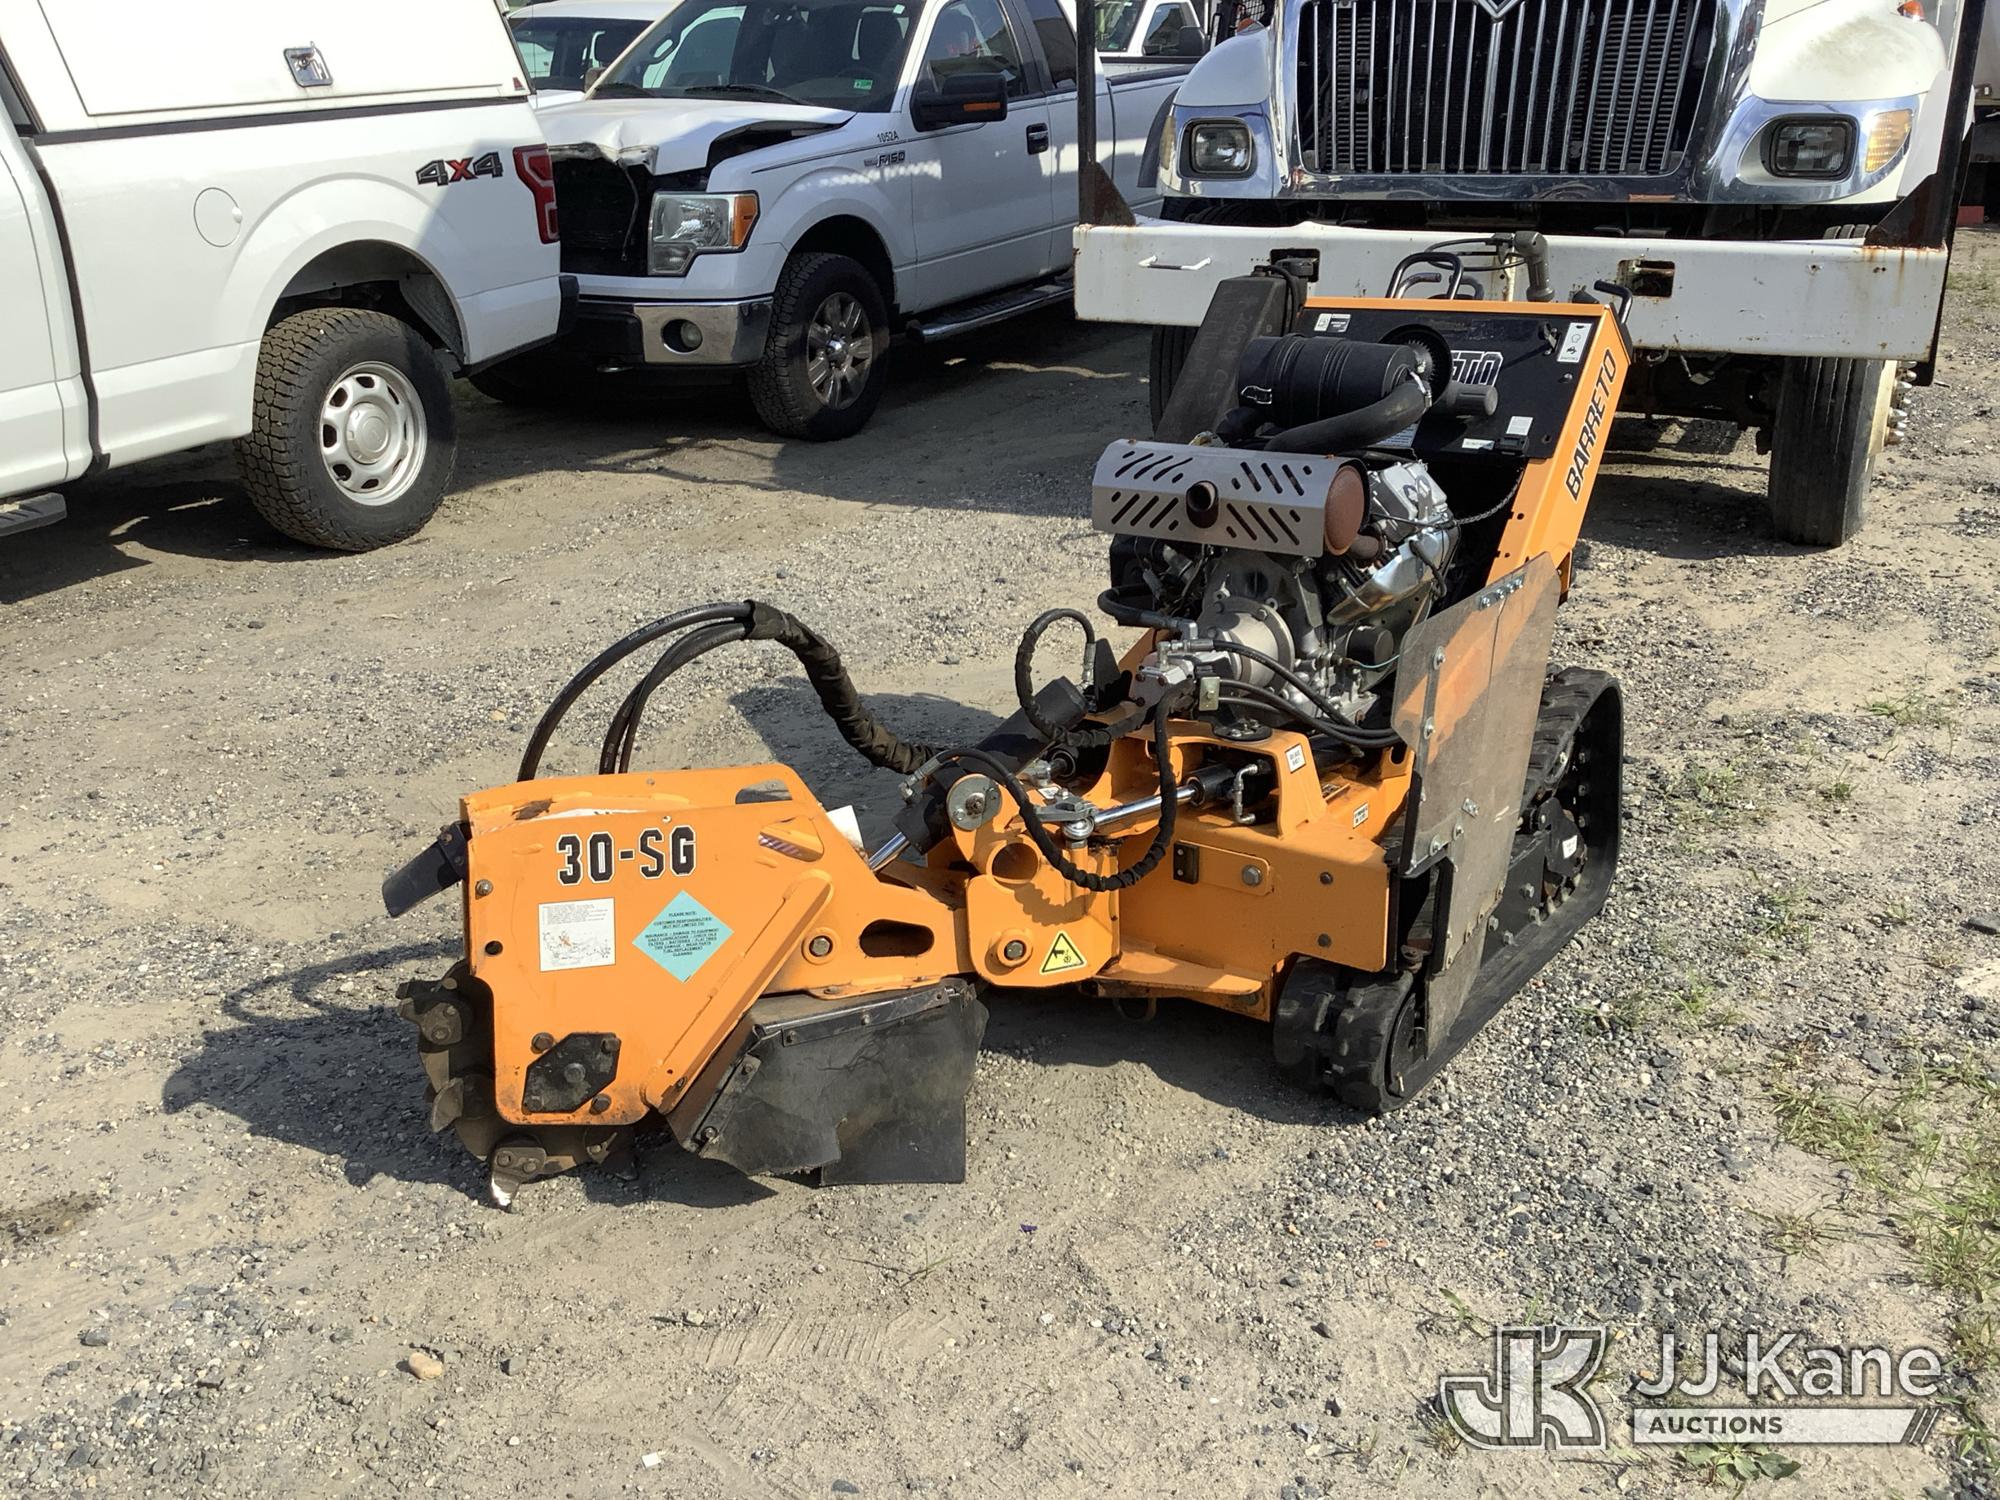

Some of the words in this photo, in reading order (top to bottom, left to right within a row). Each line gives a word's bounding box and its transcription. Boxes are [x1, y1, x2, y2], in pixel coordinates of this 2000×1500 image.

[877, 130, 899, 143] 1052A
[1565, 348, 1617, 504] BARRETO
[556, 825, 696, 886] 30-SG
